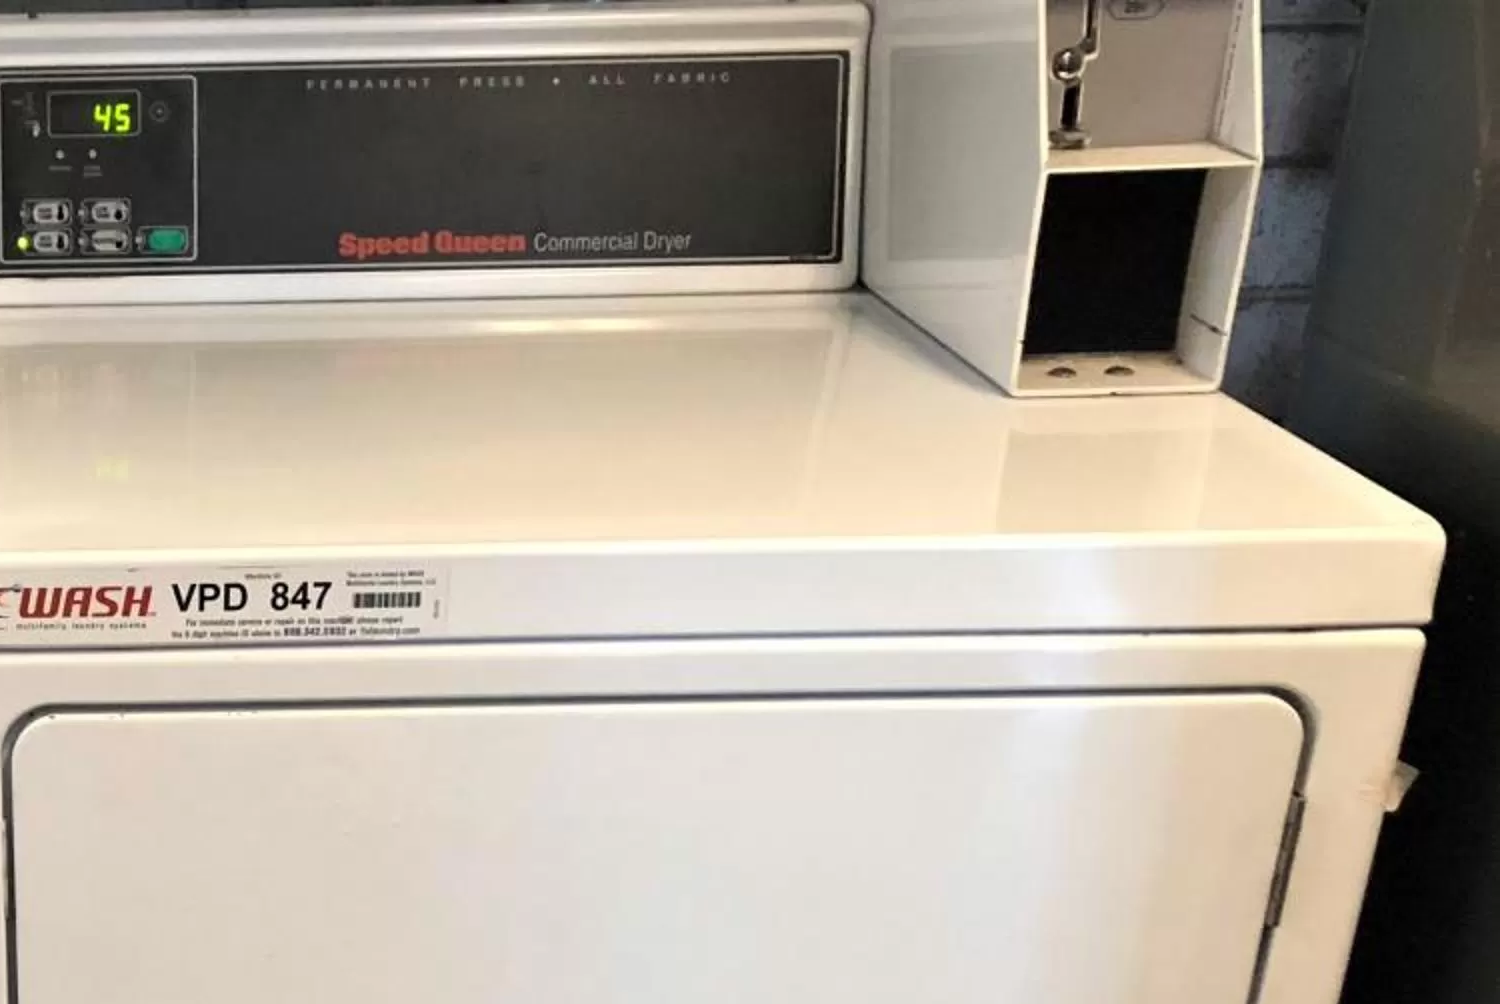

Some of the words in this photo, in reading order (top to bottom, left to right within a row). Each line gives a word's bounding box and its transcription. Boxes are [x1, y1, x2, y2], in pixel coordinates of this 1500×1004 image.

[306, 77, 431, 90] PERMANENT
[459, 75, 525, 89] PRESS
[588, 73, 626, 86] ALL
[653, 71, 731, 84] FABRIC
[93, 103, 131, 132] 45
[339, 230, 429, 260] Speed
[434, 229, 527, 254] Queen
[533, 230, 639, 253] Commercial
[643, 230, 693, 255] Dryer
[19, 585, 153, 619] WASH
[171, 583, 248, 612] VPD
[269, 581, 333, 612] 847
